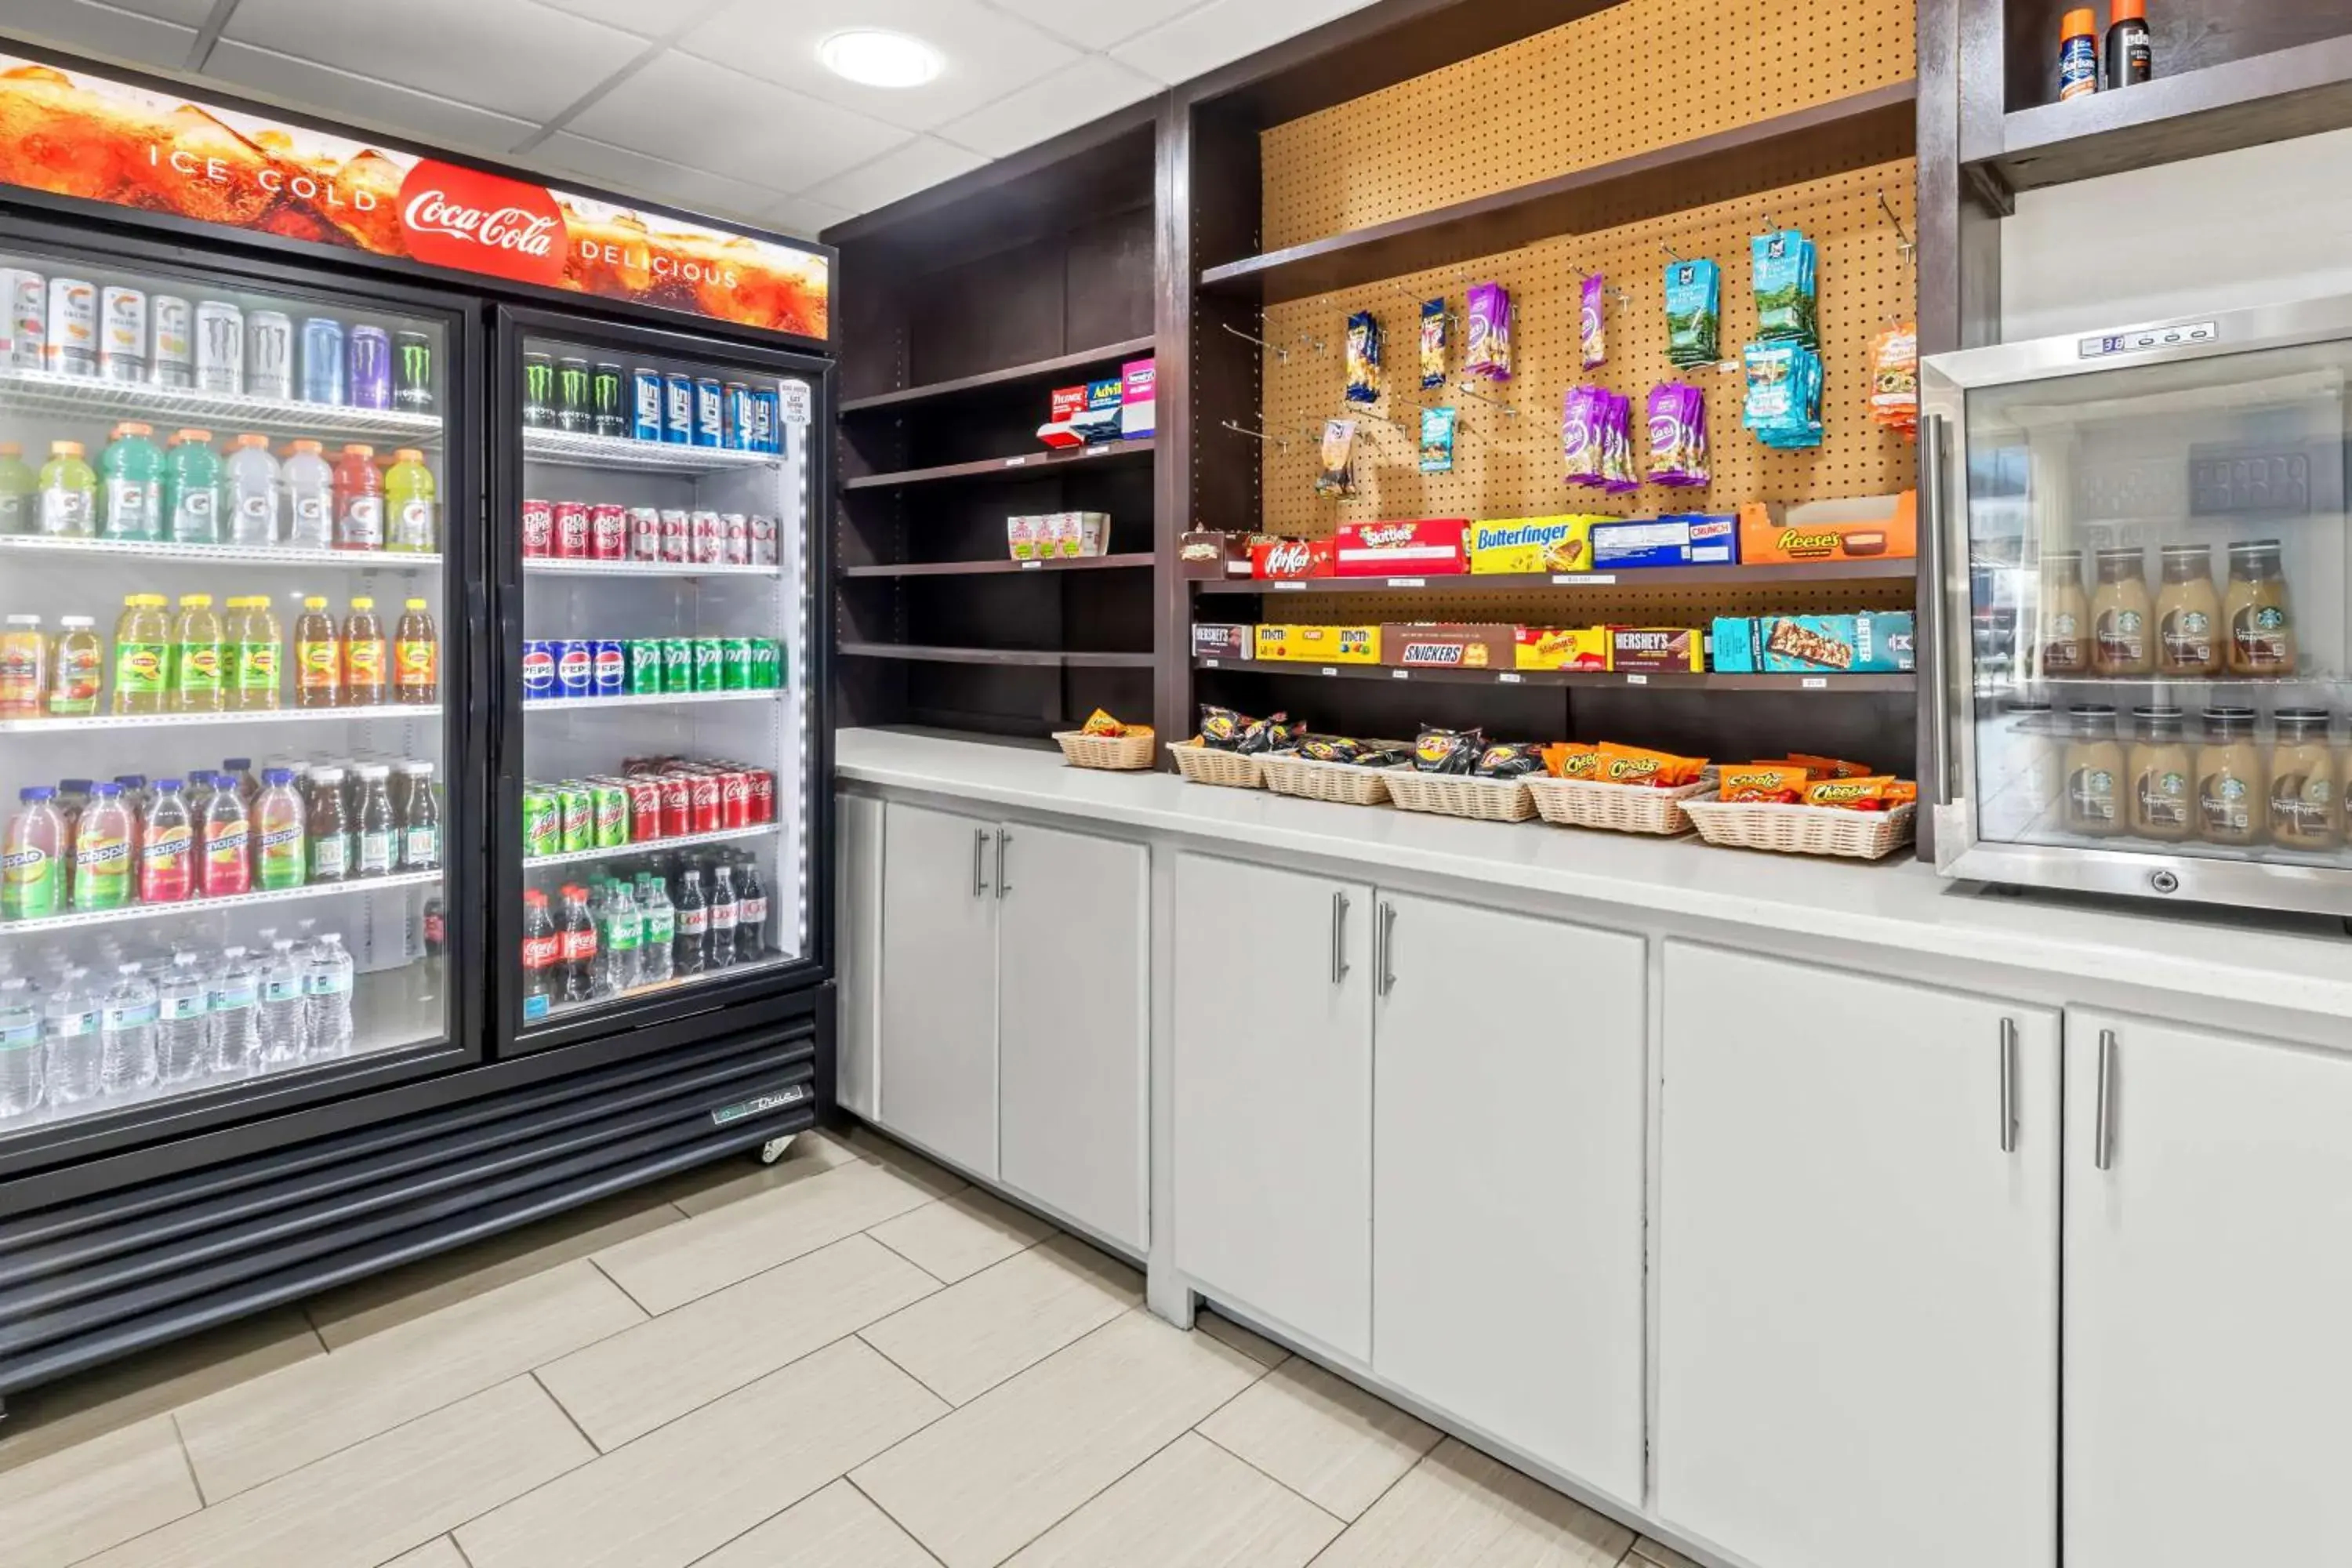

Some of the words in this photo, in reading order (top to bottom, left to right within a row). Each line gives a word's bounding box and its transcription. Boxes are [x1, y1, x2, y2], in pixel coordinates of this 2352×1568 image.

[150, 144, 227, 182] ICE
[259, 169, 377, 212] COLD
[404, 190, 557, 257] Coca-Cola
[580, 239, 739, 290] DELICIOUS
[1478, 524, 1568, 550] Butterfinger
[1777, 528, 1841, 550] Reese's
[1405, 644, 1461, 662] SNICKERS
[1615, 633, 1668, 650] HERSHEY'S
